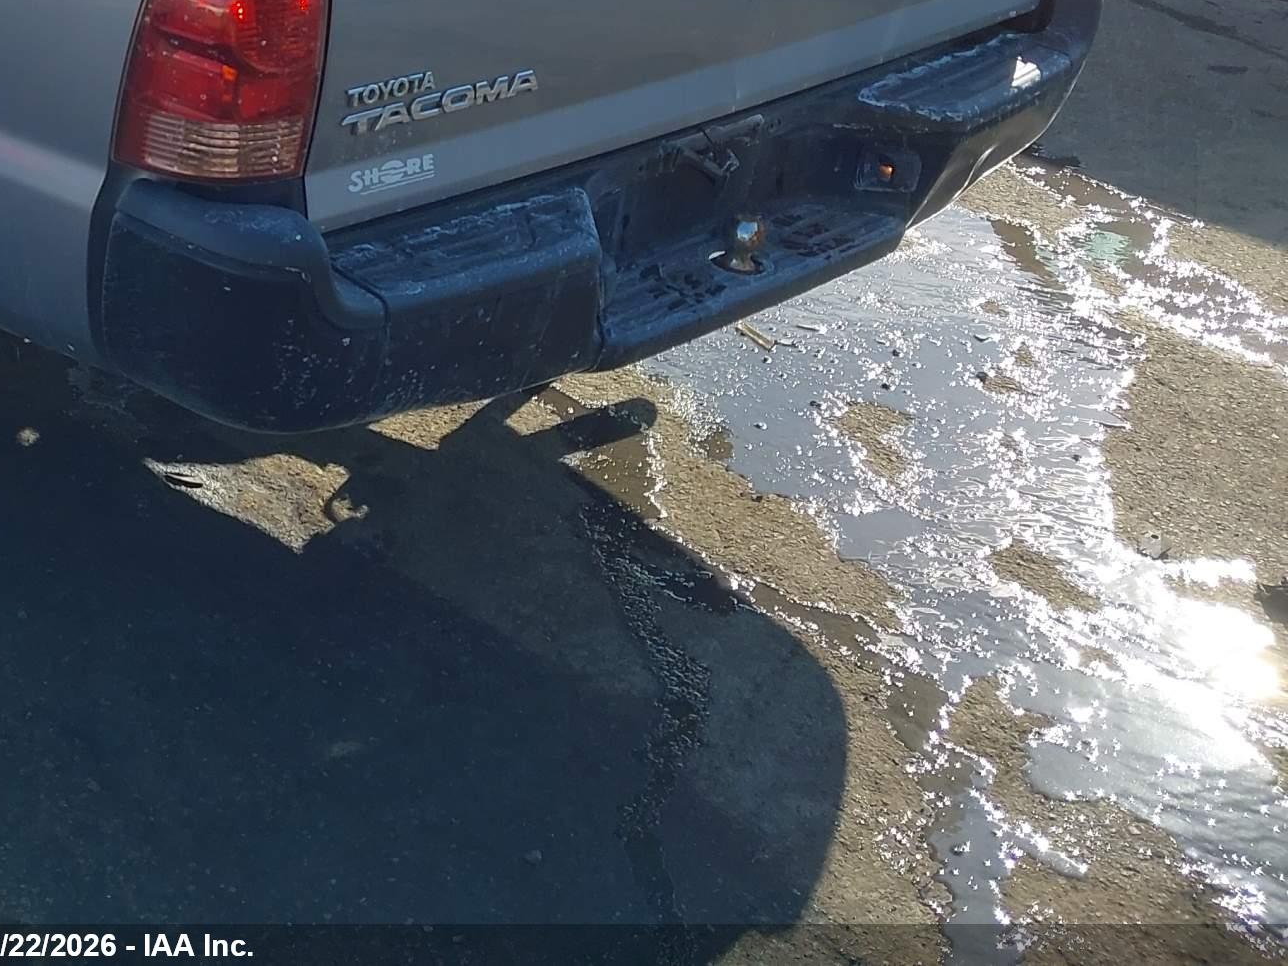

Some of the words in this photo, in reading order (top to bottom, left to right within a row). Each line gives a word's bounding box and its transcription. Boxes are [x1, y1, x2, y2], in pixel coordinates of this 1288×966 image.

[341, 69, 539, 135] TACOMA
[346, 71, 436, 107] TOYOTA
[347, 153, 435, 193] SHORE
